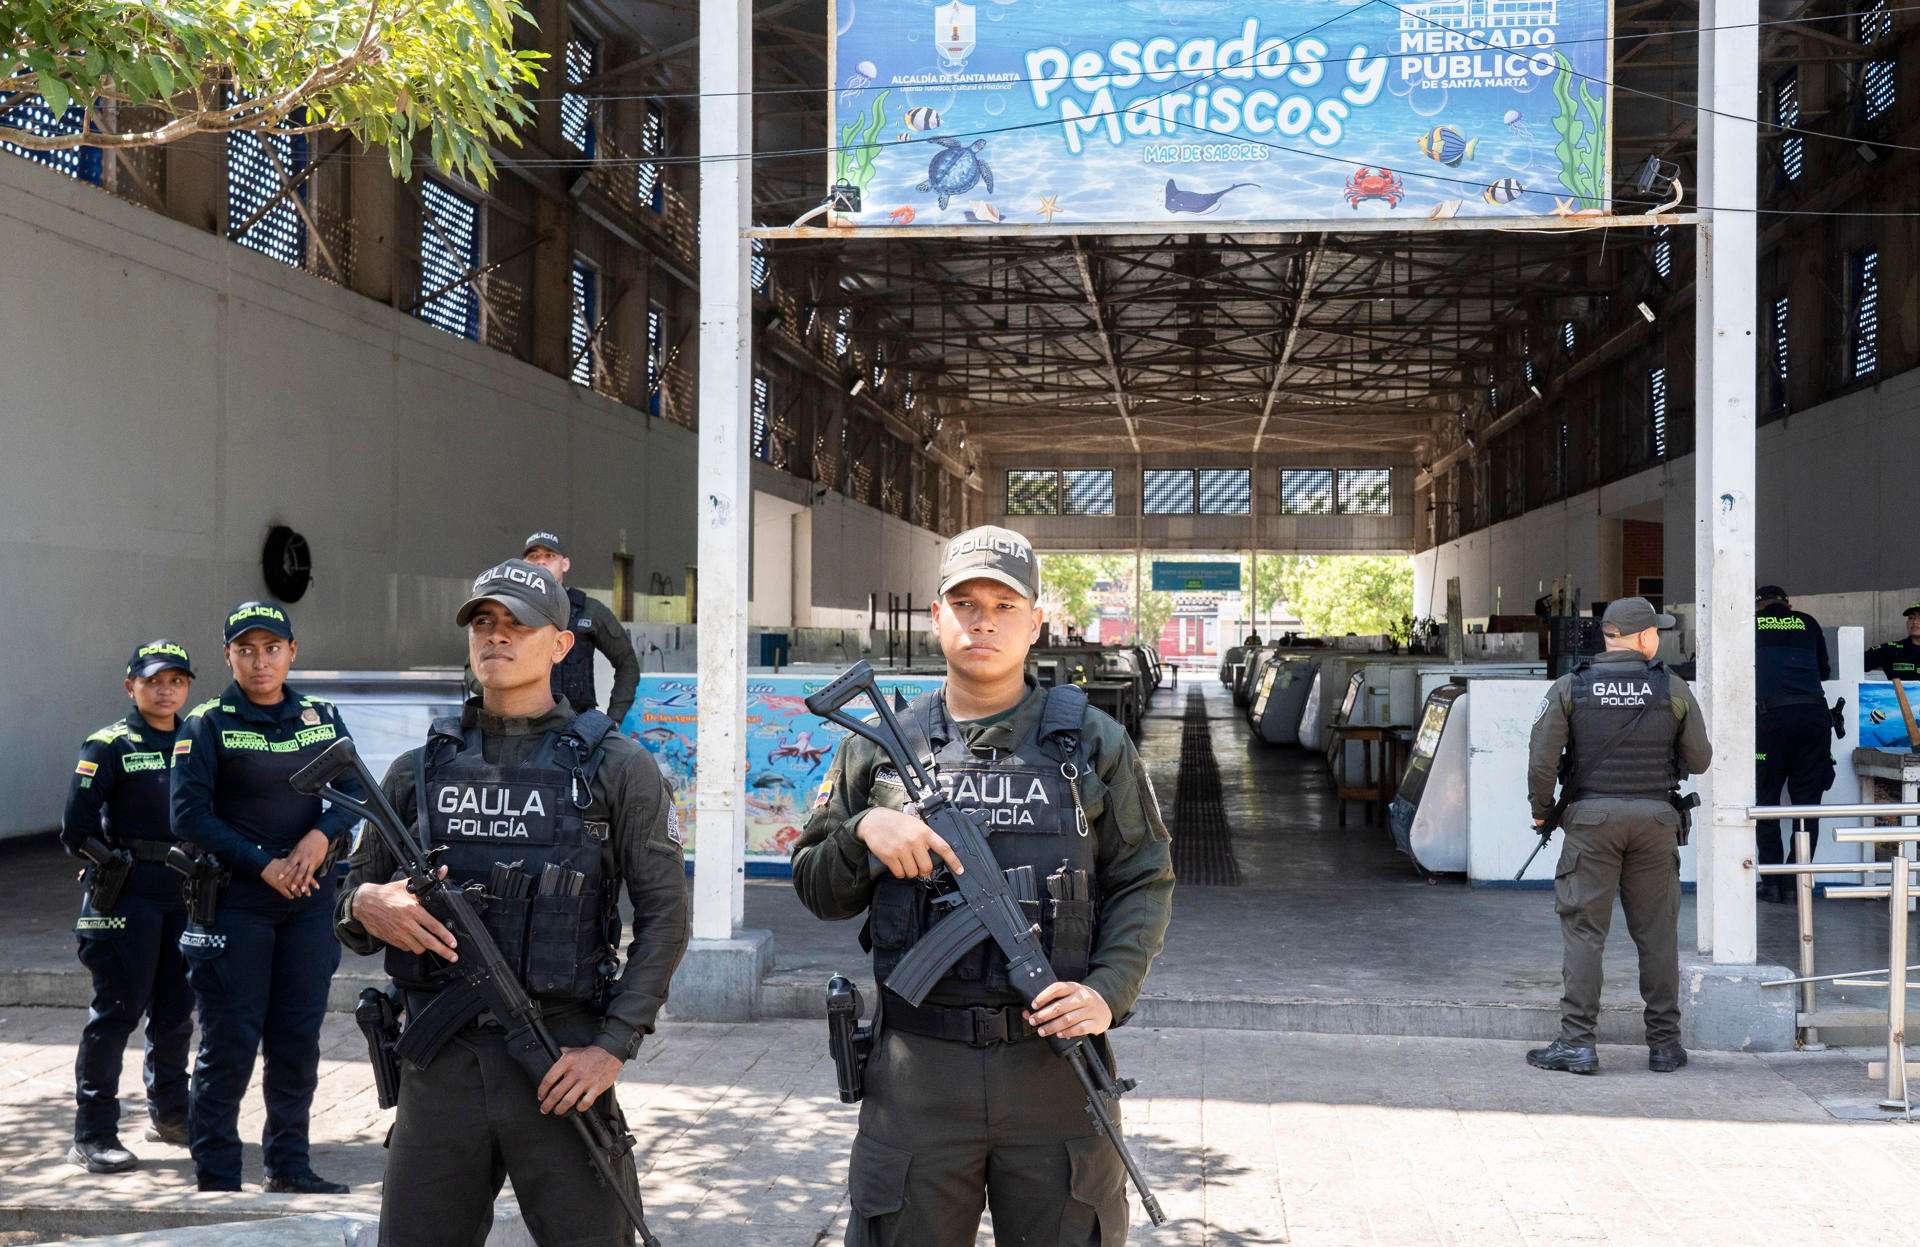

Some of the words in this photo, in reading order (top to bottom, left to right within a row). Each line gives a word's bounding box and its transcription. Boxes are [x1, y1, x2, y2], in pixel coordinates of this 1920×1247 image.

[1400, 27, 1555, 53] MERCADO
[1028, 18, 1328, 108] Pescados
[1341, 45, 1389, 105] y
[891, 72, 938, 84] ALCALDÍA
[939, 74, 951, 83] DE
[952, 73, 985, 83] SANTA
[987, 72, 1021, 82] MARTA
[1421, 80, 1438, 89] DE
[1441, 79, 1482, 88] SANTA
[1485, 77, 1528, 87] MARTA
[1060, 85, 1348, 153] Mariscos
[1145, 145, 1179, 162] MAR
[1180, 145, 1201, 162] DE
[1203, 143, 1269, 161] SABORES
[472, 565, 546, 594] POLICÍA
[1756, 615, 1805, 626] POLICÍA
[1592, 682, 1653, 696] GAULA
[1600, 695, 1646, 706] POLICÍA
[437, 786, 546, 817] GAULA
[447, 817, 529, 838] POLICÍA
